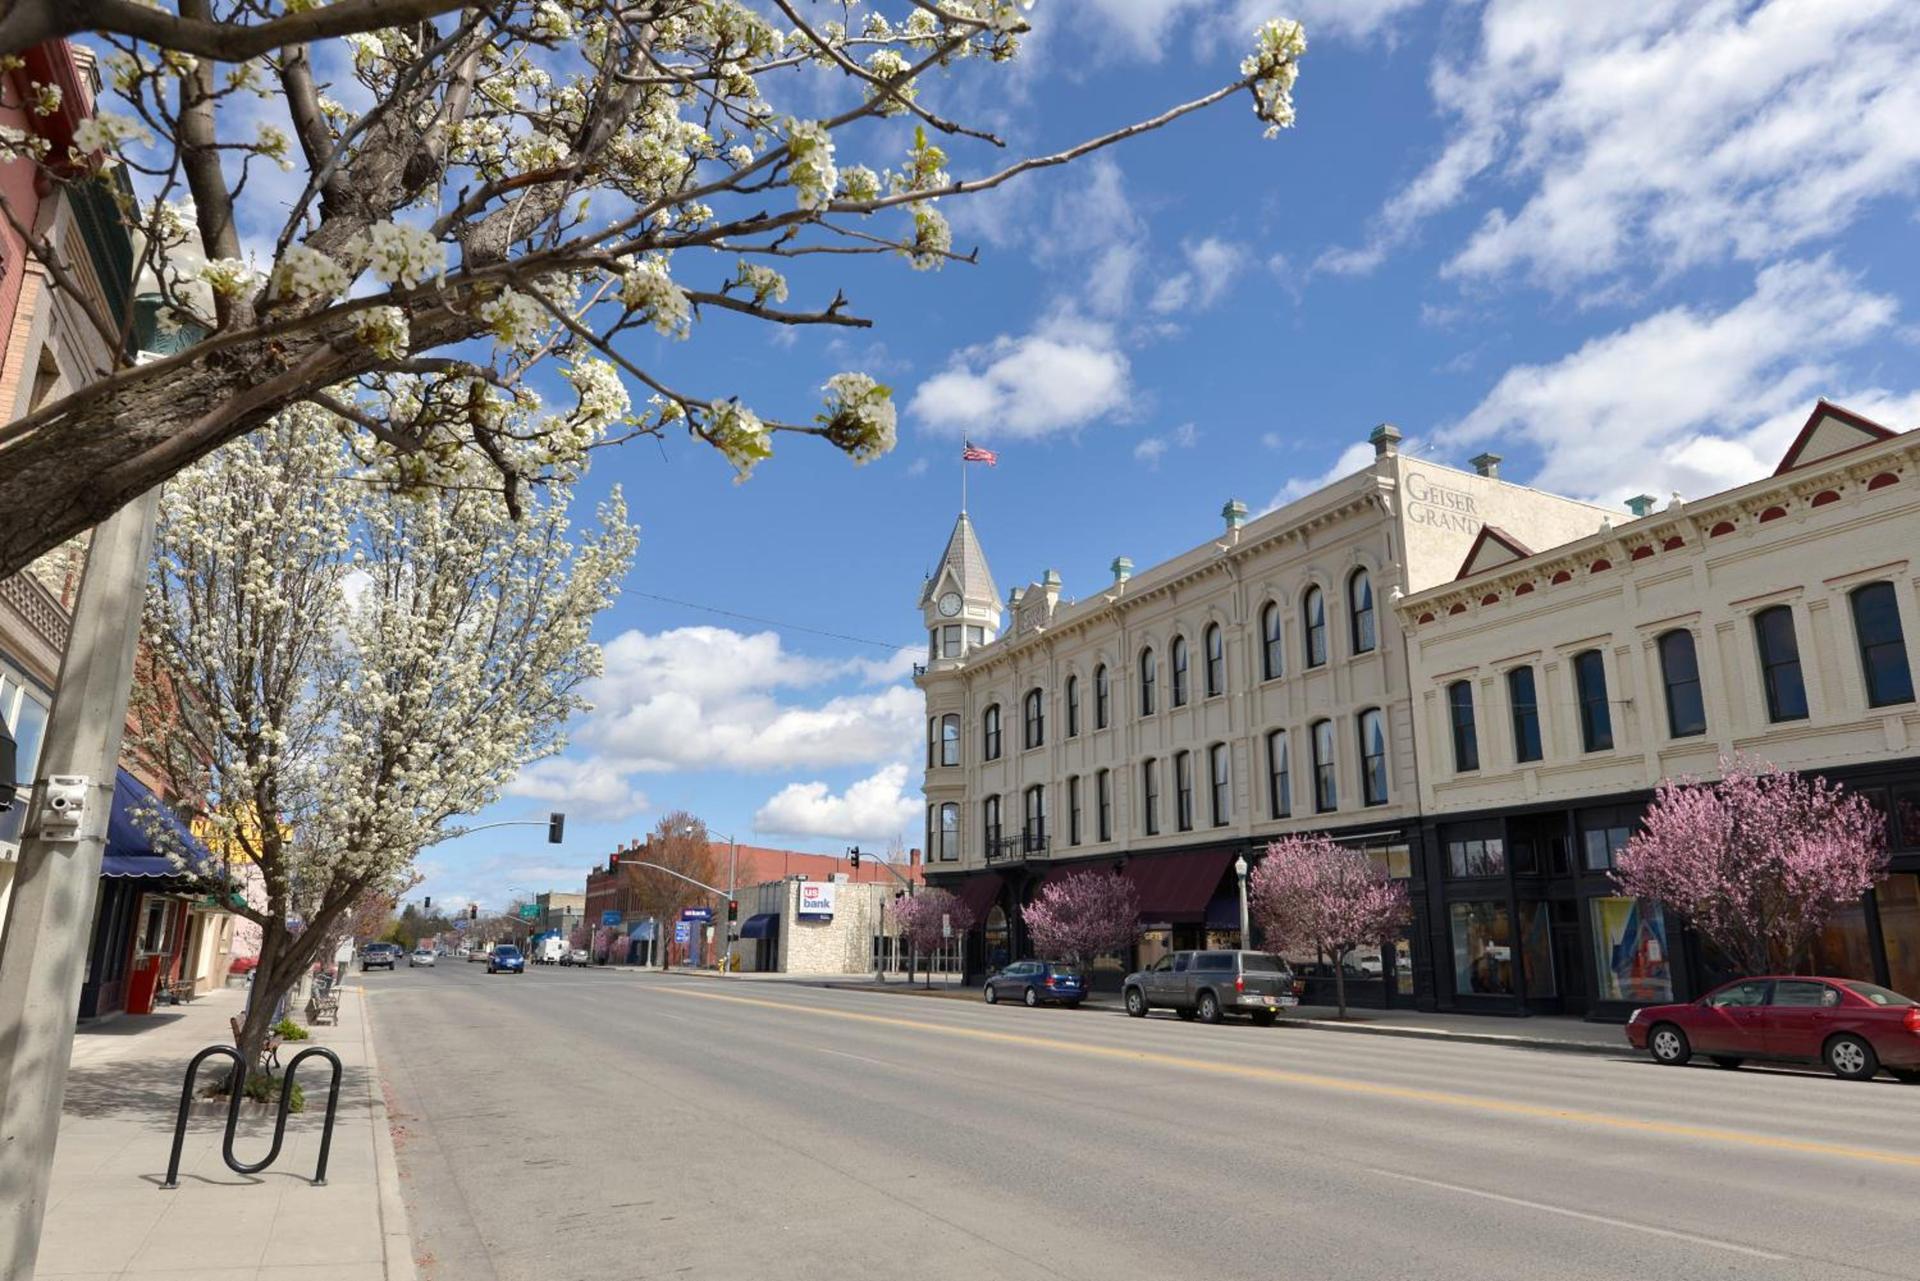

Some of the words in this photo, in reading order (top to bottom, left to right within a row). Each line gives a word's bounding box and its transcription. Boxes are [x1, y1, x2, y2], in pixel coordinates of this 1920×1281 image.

[1406, 473, 1478, 514] GEISER
[1408, 501, 1480, 534] GRAND
[803, 898, 830, 908] bank
